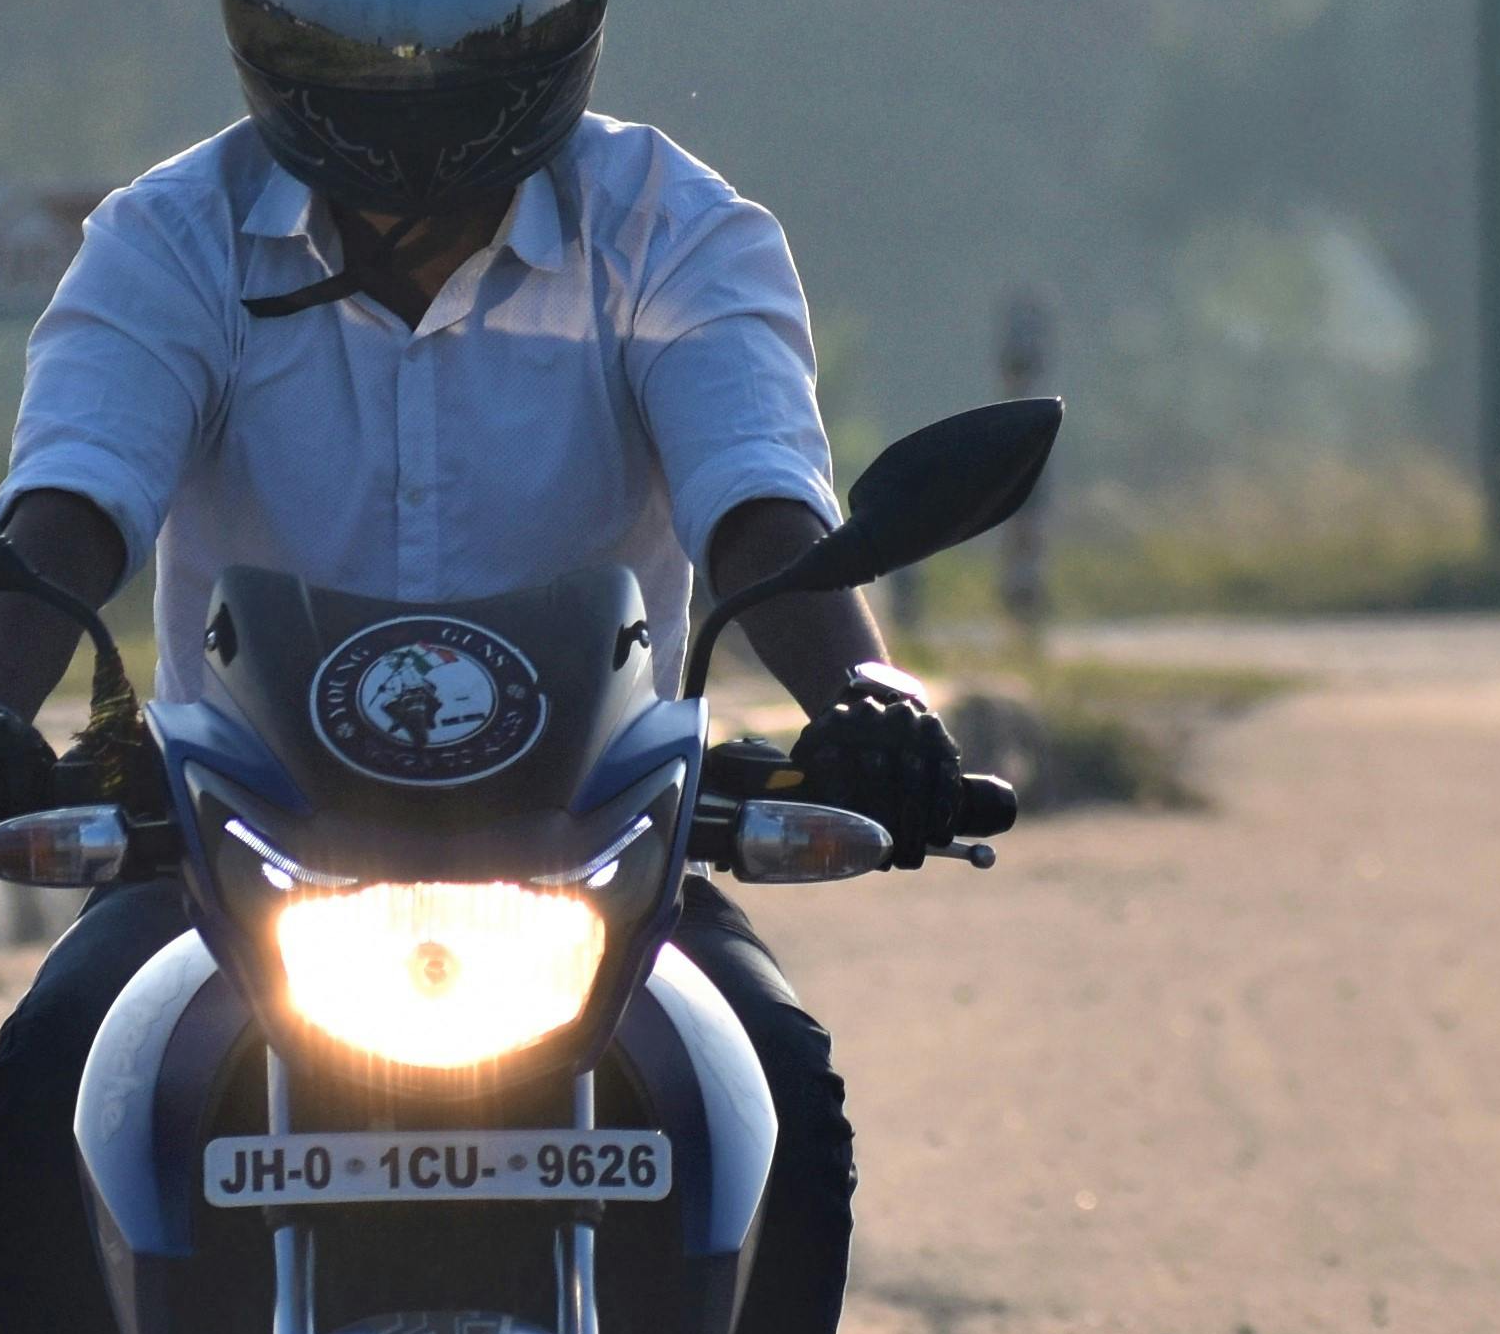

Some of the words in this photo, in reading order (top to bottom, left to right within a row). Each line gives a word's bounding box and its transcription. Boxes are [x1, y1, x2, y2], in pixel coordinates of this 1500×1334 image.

[328, 646, 370, 720] YOUNG
[440, 627, 506, 668] GUNS
[220, 1146, 332, 1194] JH-0
[380, 1145, 496, 1189] 1CU-
[538, 1143, 657, 1189] 9626
